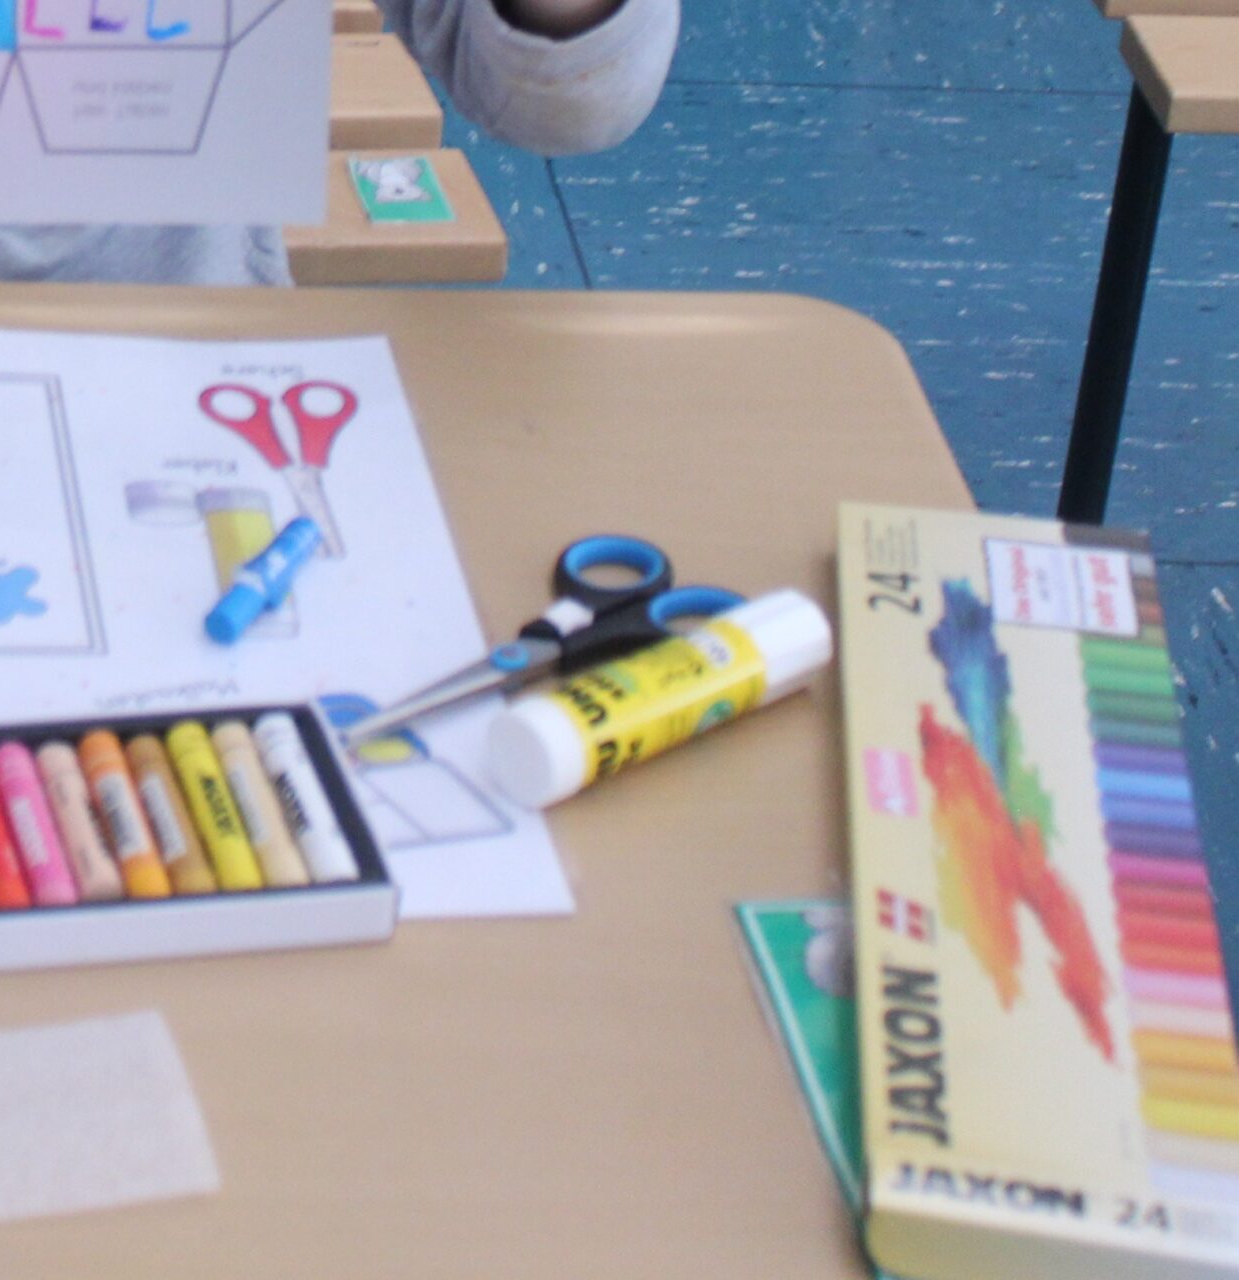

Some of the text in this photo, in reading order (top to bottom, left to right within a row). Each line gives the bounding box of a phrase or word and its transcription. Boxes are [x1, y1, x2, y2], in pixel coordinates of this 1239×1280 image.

[866, 571, 922, 616] 24
[878, 963, 952, 1149] JAXON
[889, 1161, 1087, 1221] JAXON
[1114, 1195, 1173, 1234] 24
